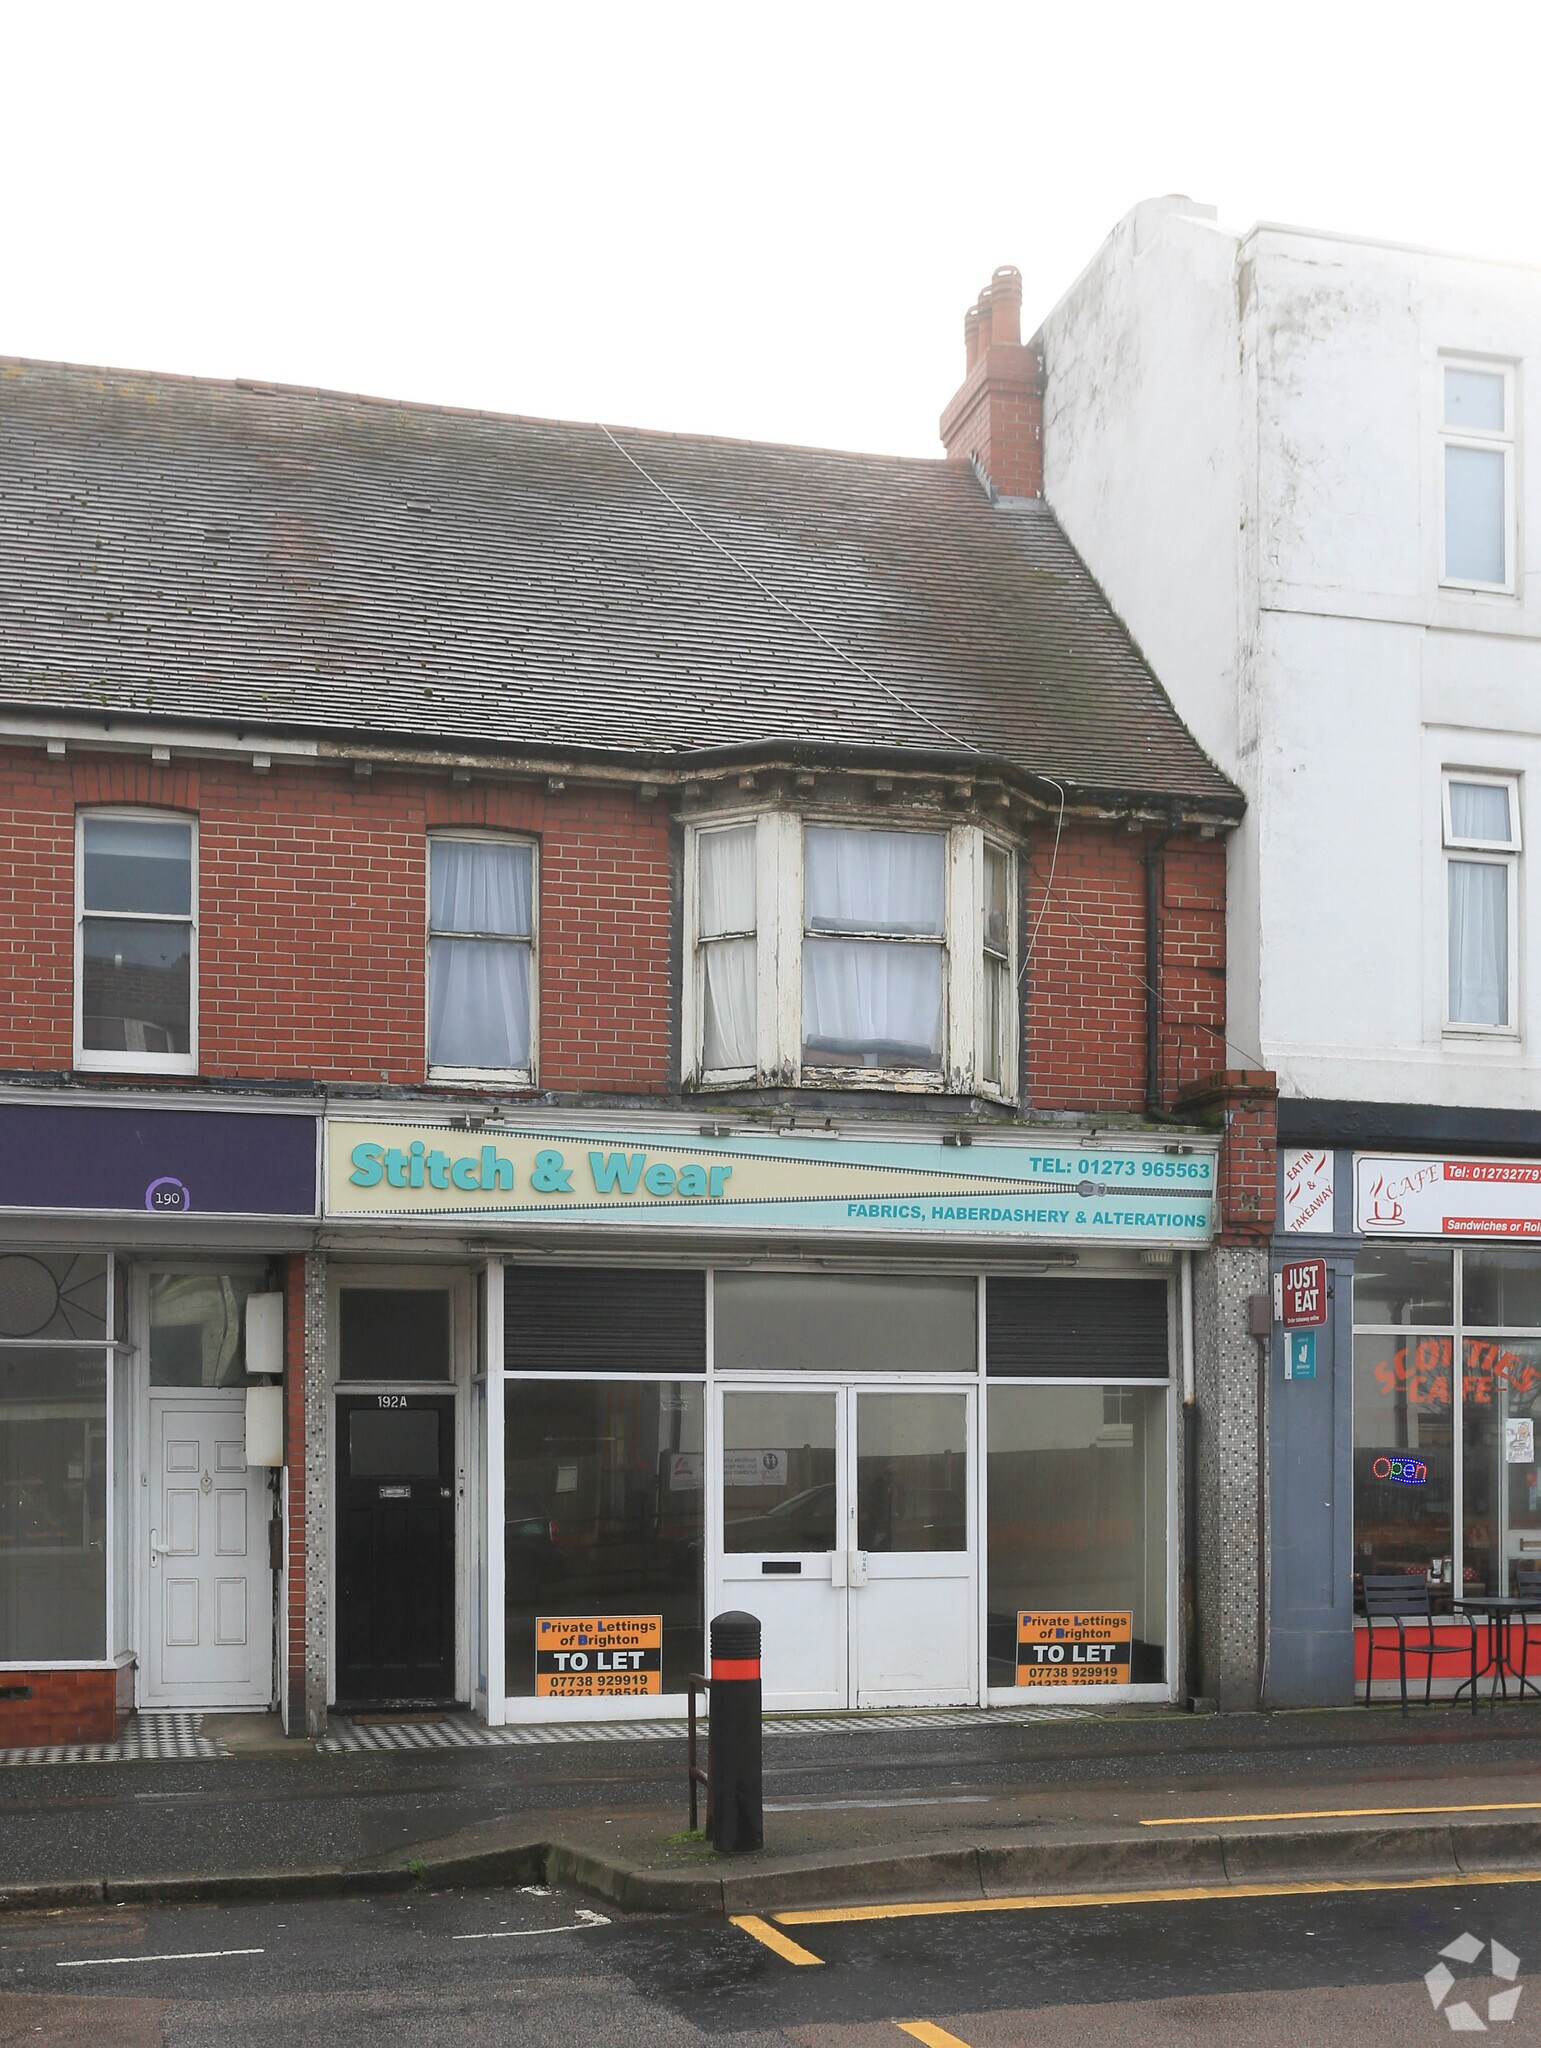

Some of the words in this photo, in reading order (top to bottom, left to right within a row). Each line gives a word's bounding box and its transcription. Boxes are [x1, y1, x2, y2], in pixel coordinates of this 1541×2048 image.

[348, 1140, 514, 1191] Stitch
[530, 1149, 575, 1193] &
[588, 1151, 733, 1197] Wear
[1029, 1157, 1072, 1174] TEL:
[1078, 1159, 1136, 1176] 01273
[1141, 1161, 1210, 1179] 965563
[1286, 1161, 1304, 1181] EAT
[1301, 1151, 1314, 1165] IN
[1449, 1165, 1470, 1178] Tel:
[1473, 1167, 1541, 1180] 012732779
[1306, 1180, 1316, 1190] &
[1386, 1164, 1439, 1200] CAFE
[155, 1193, 180, 1205] 190
[847, 1204, 926, 1222] FABRICS,
[931, 1206, 1070, 1224] HABERDASHERY
[1075, 1210, 1087, 1224] &
[1093, 1211, 1206, 1228] ALTERATIONS
[1290, 1185, 1333, 1232] TAKEAWAY
[1447, 1220, 1507, 1231] Sandwiches
[1510, 1223, 1521, 1231] or
[1523, 1222, 1541, 1232] Rol
[1287, 1265, 1318, 1290] JUST
[1295, 1289, 1319, 1312] EAT
[377, 1395, 407, 1408] 192A
[1373, 1457, 1427, 1480] Open
[542, 1622, 593, 1633] Private
[598, 1621, 656, 1633] Lettings
[1023, 1616, 1069, 1626] Private
[1074, 1616, 1127, 1628] Lettings
[560, 1635, 575, 1645] of
[578, 1635, 639, 1647] Brighton
[1040, 1629, 1053, 1638] of
[1056, 1628, 1110, 1640] Brighton
[553, 1653, 589, 1671] TO
[597, 1651, 645, 1670] LET
[1033, 1645, 1065, 1662] TO
[1072, 1645, 1115, 1662] LET
[1029, 1668, 1067, 1677] 07738
[1072, 1667, 1117, 1676] 929919
[550, 1676, 593, 1687] 07738
[597, 1675, 648, 1685] 929919
